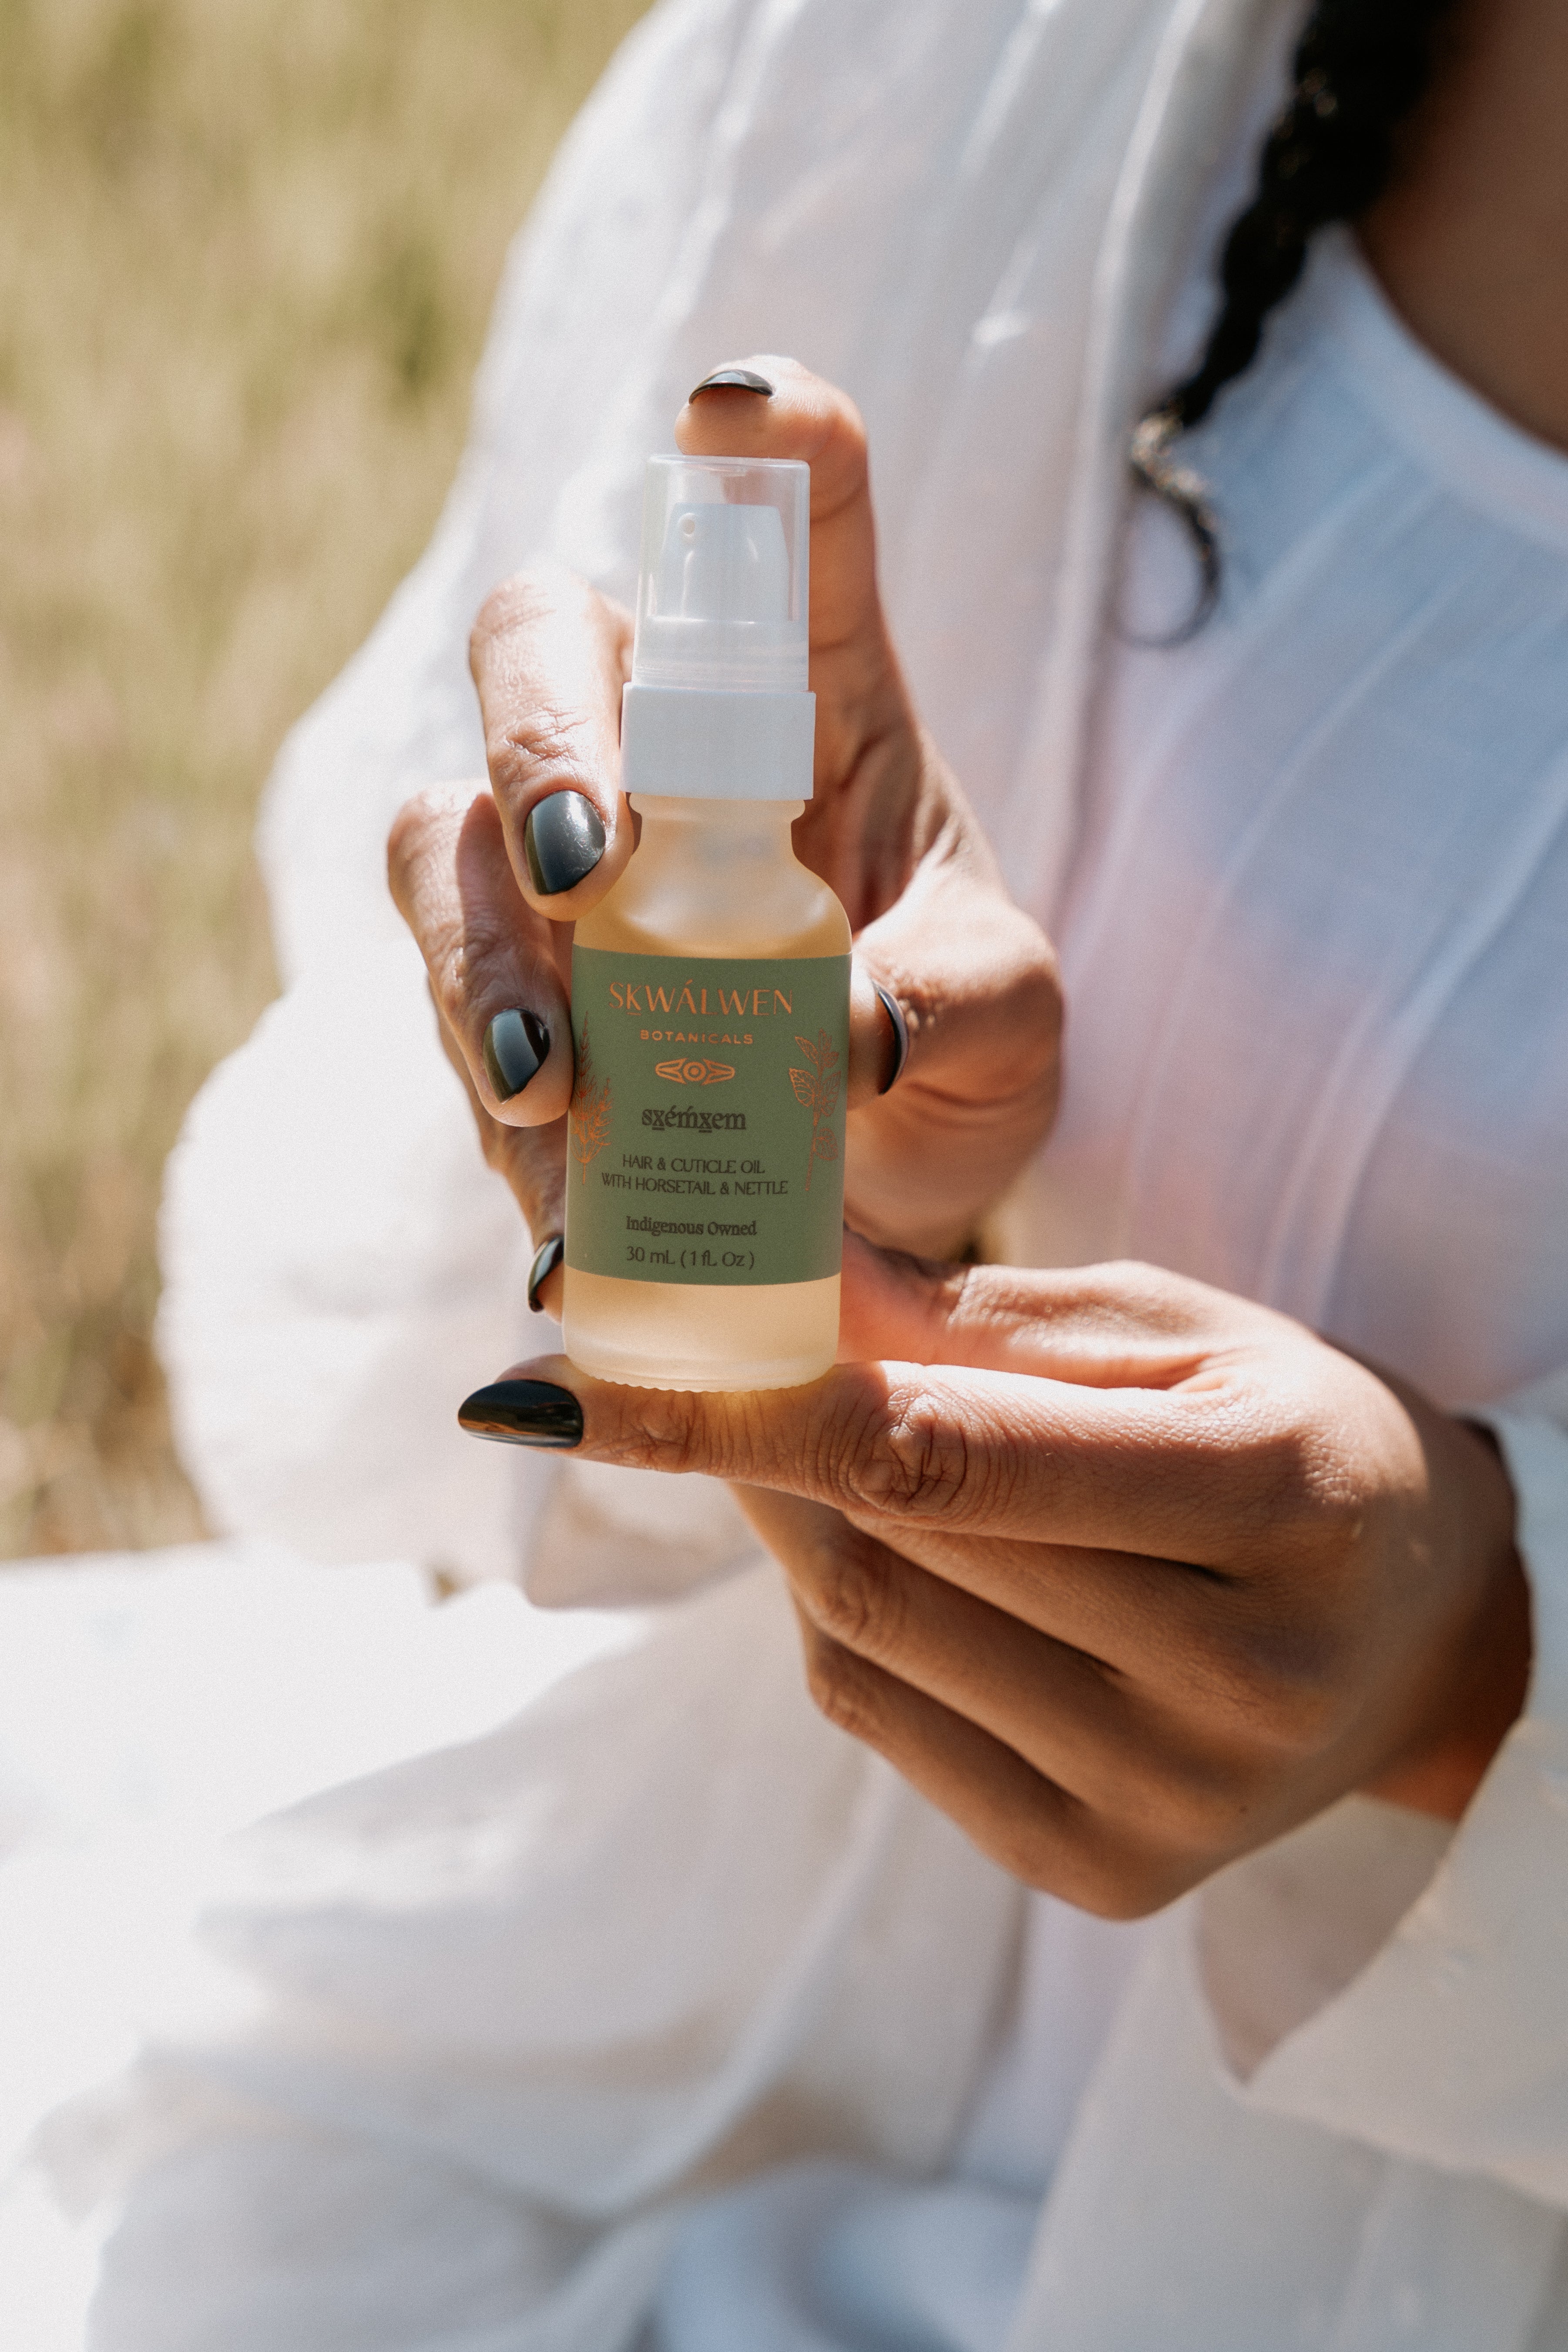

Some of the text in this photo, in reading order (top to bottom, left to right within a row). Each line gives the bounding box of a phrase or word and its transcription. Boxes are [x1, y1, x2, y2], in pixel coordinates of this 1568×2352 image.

[640, 1029, 754, 1045] BOTANICALS
[623, 1154, 765, 1174] HAIR & CUTICLE OIL
[602, 1172, 789, 1195] WITH HORSETAIL & NETTLE
[626, 1216, 757, 1236] Indigenous Owned
[627, 1246, 645, 1262] 30
[650, 1250, 675, 1264] mL
